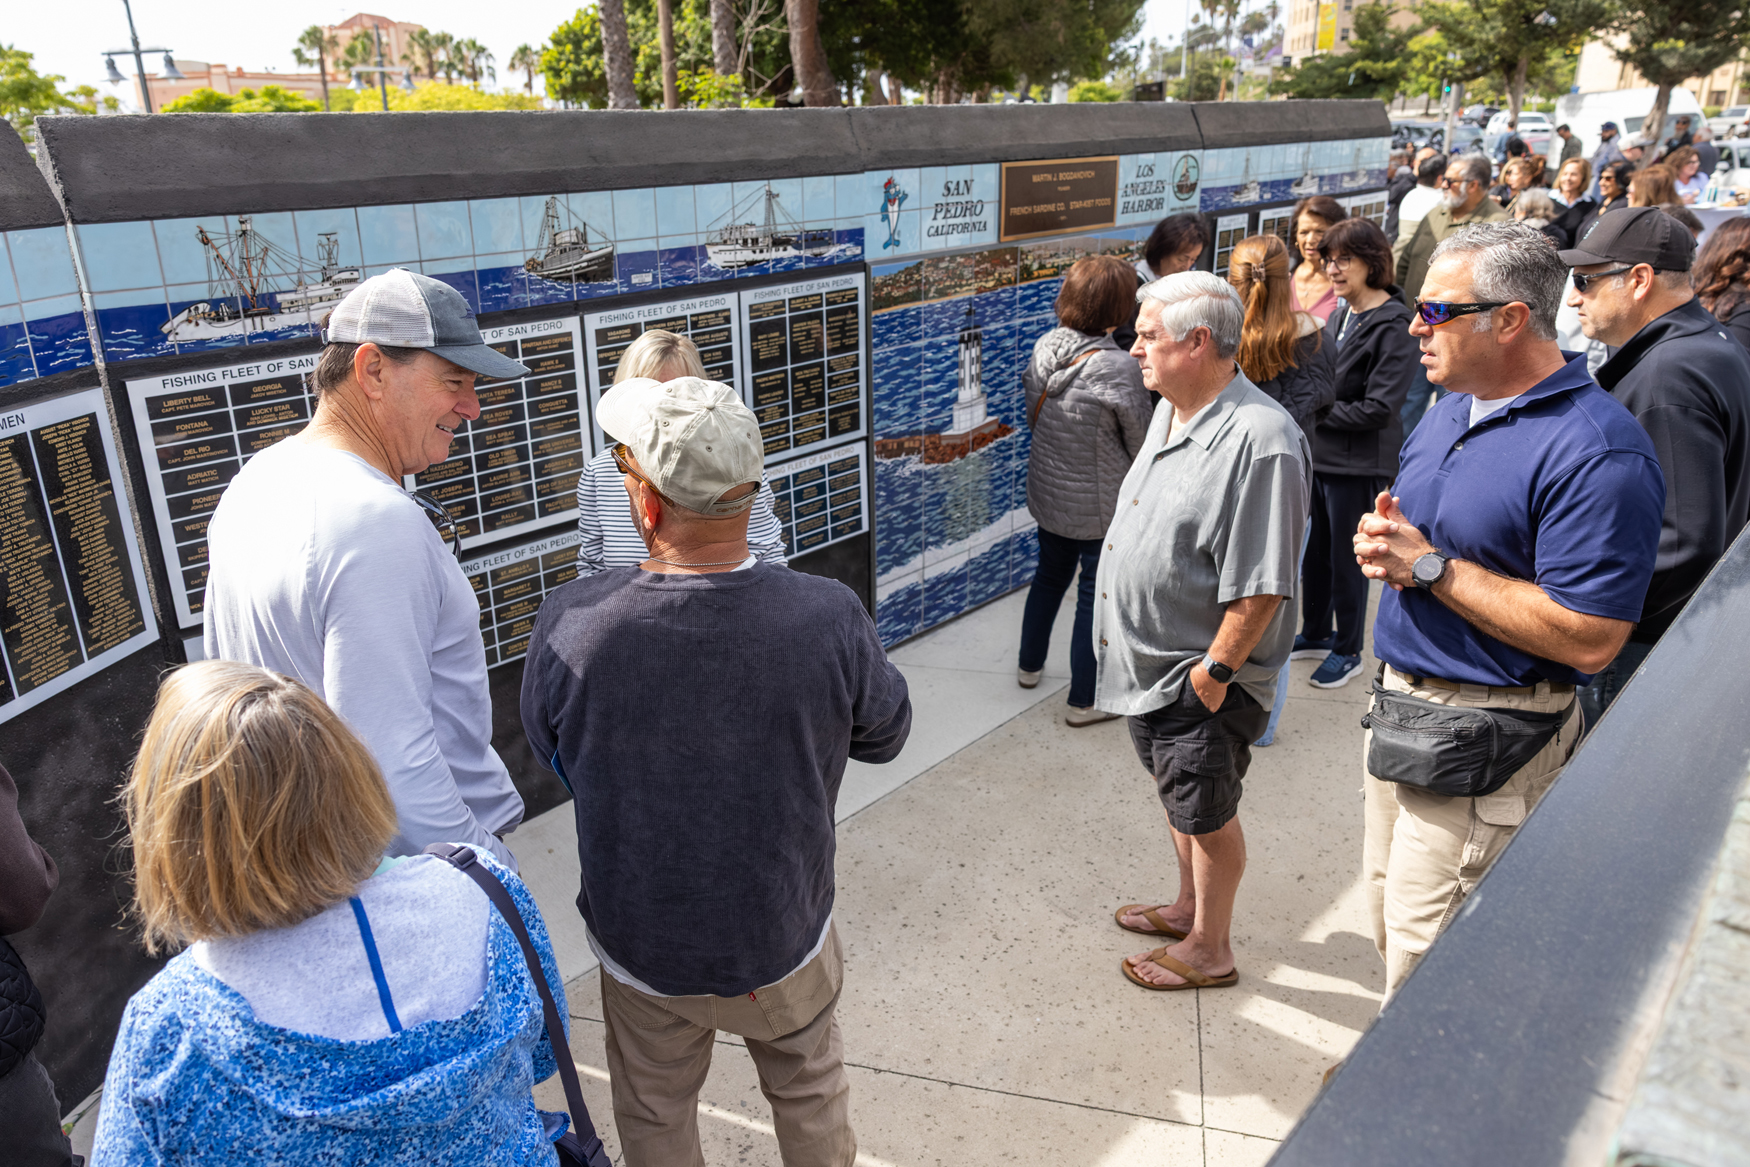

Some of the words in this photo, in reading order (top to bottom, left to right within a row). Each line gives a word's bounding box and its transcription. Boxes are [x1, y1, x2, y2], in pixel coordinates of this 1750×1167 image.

[1032, 173, 1052, 182] MARTIN
[1136, 164, 1155, 178] LOS
[942, 179, 974, 197] SAN
[1121, 179, 1166, 197] ANGELES
[932, 199, 984, 220] PEDRO
[1010, 206, 1032, 216] FRENCH
[1033, 203, 1056, 213] SARDINE
[1095, 198, 1111, 206] FOODS
[1121, 197, 1164, 214] HARBOR
[927, 221, 987, 238] CALIFORNIA
[754, 289, 781, 299] FISHING
[784, 285, 803, 294] FLEET
[817, 281, 830, 290] SAN
[832, 278, 853, 287] PEDRO
[600, 312, 634, 324] FISHING
[638, 307, 663, 317] FLEET
[666, 305, 677, 314] OF
[680, 301, 697, 311] SAN
[700, 298, 726, 308] PEDRO
[508, 326, 528, 336] SAN
[531, 321, 563, 332] PEDRO
[162, 372, 216, 389] FISHING
[222, 365, 262, 380] FLEET
[267, 362, 283, 373] OF
[289, 358, 314, 370] SAN
[252, 383, 282, 392] GEORGIA
[162, 397, 192, 406] LIBERTY
[176, 420, 208, 430] FONTANA
[259, 430, 283, 438] RONNIE
[766, 467, 785, 477] SHING
[788, 460, 807, 471] FLEET
[808, 457, 817, 465] OF
[819, 453, 832, 462] SAN
[834, 447, 854, 457] PEDRO
[186, 469, 217, 480] ADRIATIC
[483, 553, 511, 568] FLEET
[514, 549, 526, 558] OF
[530, 543, 547, 554] SAN
[550, 534, 578, 548] PEDRO
